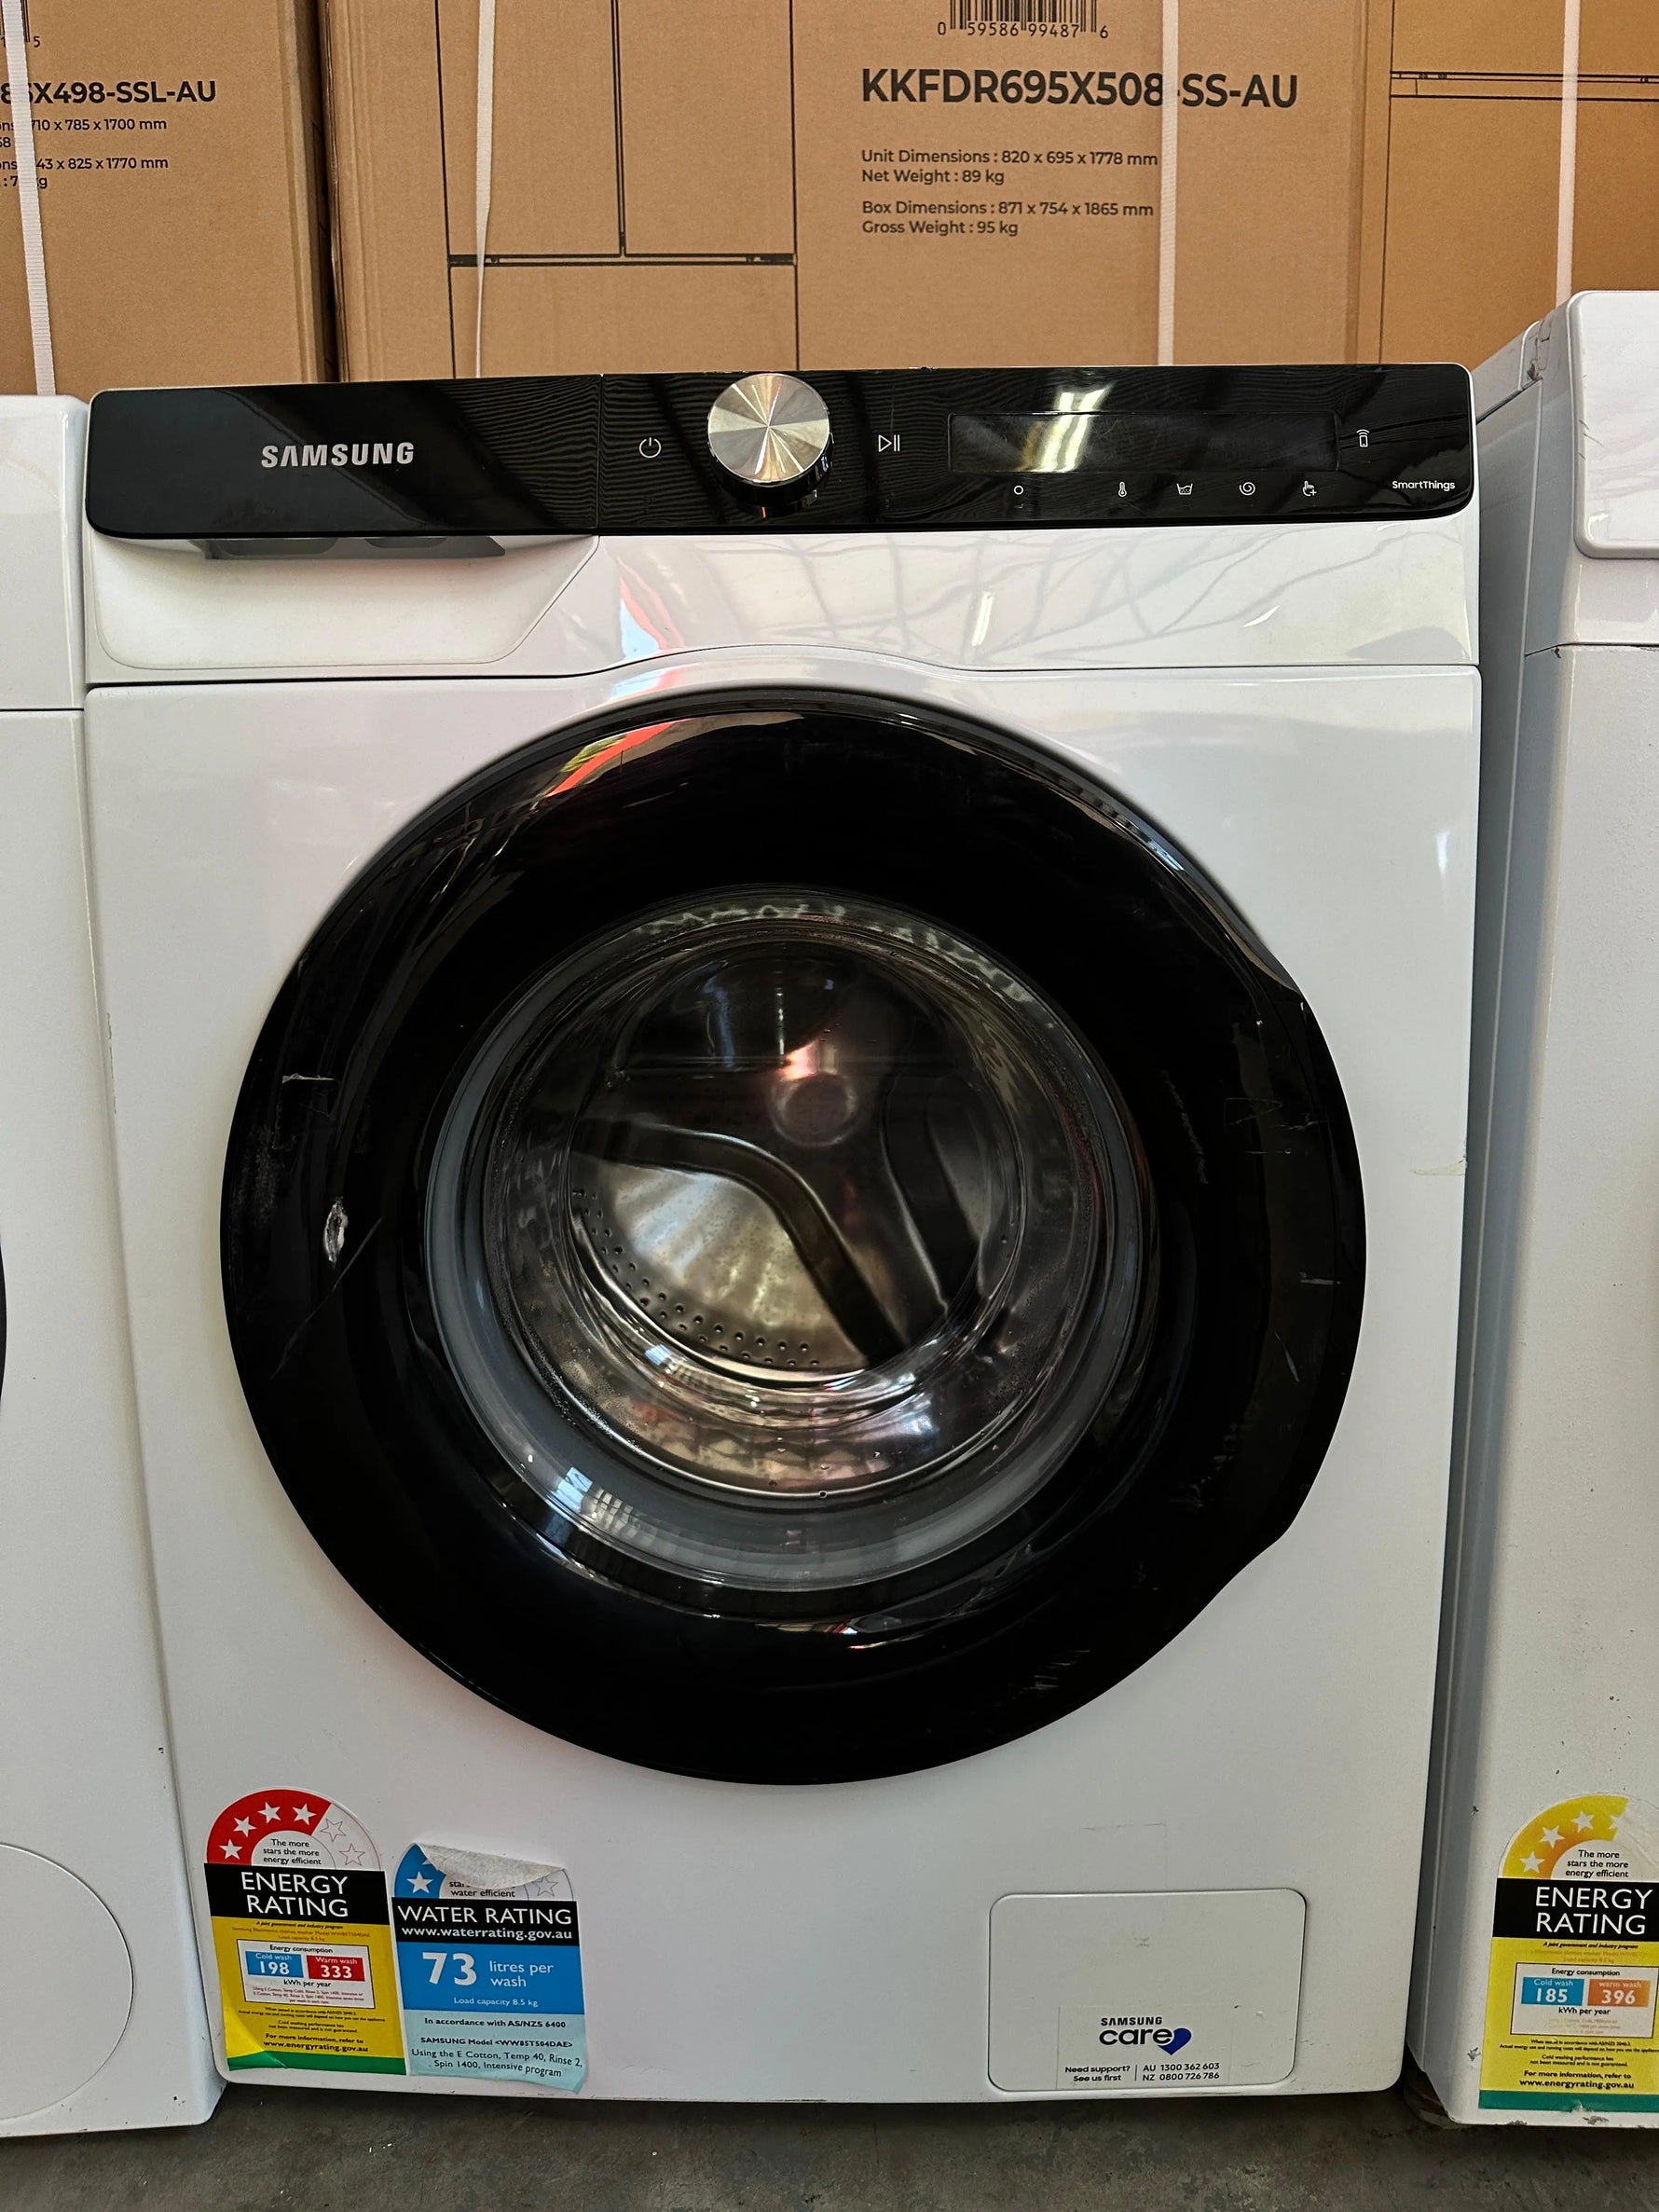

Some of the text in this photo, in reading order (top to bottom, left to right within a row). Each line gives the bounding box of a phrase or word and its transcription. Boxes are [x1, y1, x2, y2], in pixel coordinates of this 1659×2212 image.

[938, 22, 1108, 39] 0 59586 99487 6
[34, 36, 41, 48] 5
[862, 68, 1298, 108] KKFDR695X508SS-AU
[54, 121, 62, 131] x
[65, 119, 90, 130] 785
[104, 119, 135, 130] 1700
[139, 121, 167, 130] mm
[36, 158, 168, 169] 43 x 825 x 1770 mm
[862, 150, 894, 163] Unit
[899, 150, 990, 163] Dimensions
[1001, 151, 1030, 163] 820
[1034, 154, 1043, 163] x
[1047, 151, 1073, 164] 695
[1077, 155, 1086, 164] x
[1090, 151, 1123, 165] 1778
[1127, 154, 1158, 165] mm
[862, 170, 889, 183] Net
[894, 169, 951, 185] Weight
[962, 170, 981, 183] 89
[986, 169, 1004, 185] kg
[862, 201, 890, 214] Box
[896, 201, 987, 215] Dimensions
[998, 202, 1022, 214] 871
[1027, 205, 1036, 215] x
[1040, 202, 1068, 215] 754
[1072, 206, 1081, 215] x
[1085, 203, 1118, 216] 1865
[1123, 206, 1153, 216] mm
[862, 221, 905, 234] Gross
[909, 220, 966, 236] Weight
[977, 221, 995, 234] 95
[1000, 220, 1018, 236] kg
[261, 442, 414, 468] SAMSUNG
[1392, 480, 1455, 492] SmartThings
[1566, 1870, 1593, 1878] energy
[241, 1871, 348, 1894] ENERGY
[1536, 1886, 1654, 1909] ENERGY
[246, 1894, 348, 1917] RATING
[398, 1906, 572, 1924] WATER RATING
[1536, 1912, 1646, 1935] RATING
[402, 1927, 572, 1941] www.waterrating.gov.au
[260, 1962, 290, 1975] 198
[321, 1966, 352, 1978] 333
[422, 1952, 477, 1986] 73
[489, 1960, 554, 1976] litres per
[491, 1976, 526, 1987] wash
[1536, 1988, 1568, 2003] 185
[1601, 1989, 1636, 2004] 396
[1101, 2017, 1163, 2026] SAMSUNG
[298, 2035, 338, 2044] information,
[1099, 2028, 1172, 2046] care
[263, 2040, 368, 2052] www.energyrating.gov.au
[412, 2049, 437, 2058] Using
[466, 2051, 501, 2060] Cotton,
[504, 2052, 530, 2061] Temp
[532, 2053, 546, 2062] 40,
[549, 2054, 572, 2065] Rinse
[575, 2058, 583, 2068] 2,
[434, 2060, 562, 2077] Spin 1400, Intensive program
[1091, 2065, 1130, 2074] support?
[1559, 2071, 1603, 2079] information,
[1519, 2079, 1634, 2089] www.energyrating.gov.au
